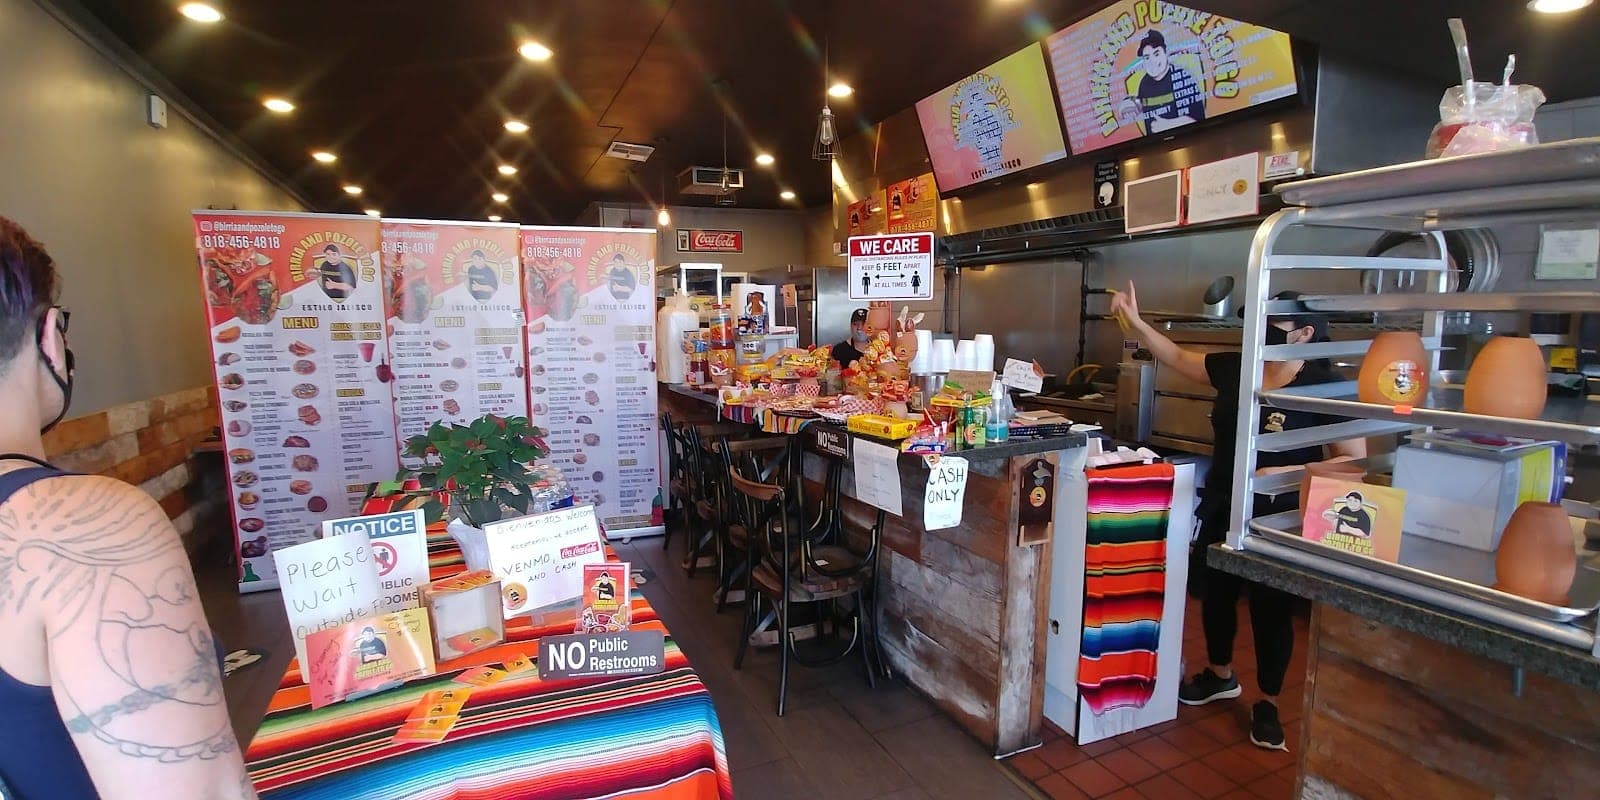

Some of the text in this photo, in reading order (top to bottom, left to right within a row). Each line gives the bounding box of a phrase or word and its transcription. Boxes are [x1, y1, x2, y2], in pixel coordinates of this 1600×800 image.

[203, 235, 281, 249] 818-456-4818
[860, 238, 920, 255] WE CARE
[290, 247, 306, 282] BIRRIA
[300, 232, 323, 251] AND
[527, 247, 582, 258] 818-456-4818
[283, 317, 318, 329] MENU
[435, 317, 464, 328] MENU
[817, 430, 827, 447] NO
[927, 489, 960, 503] ONLY
[334, 514, 416, 537] NOTICE
[1326, 532, 1371, 548] BIRRIA AND
[286, 546, 369, 584] Please
[528, 561, 577, 583] AND CASH
[548, 637, 629, 671] NO Public
[589, 654, 657, 671] Restrooms
